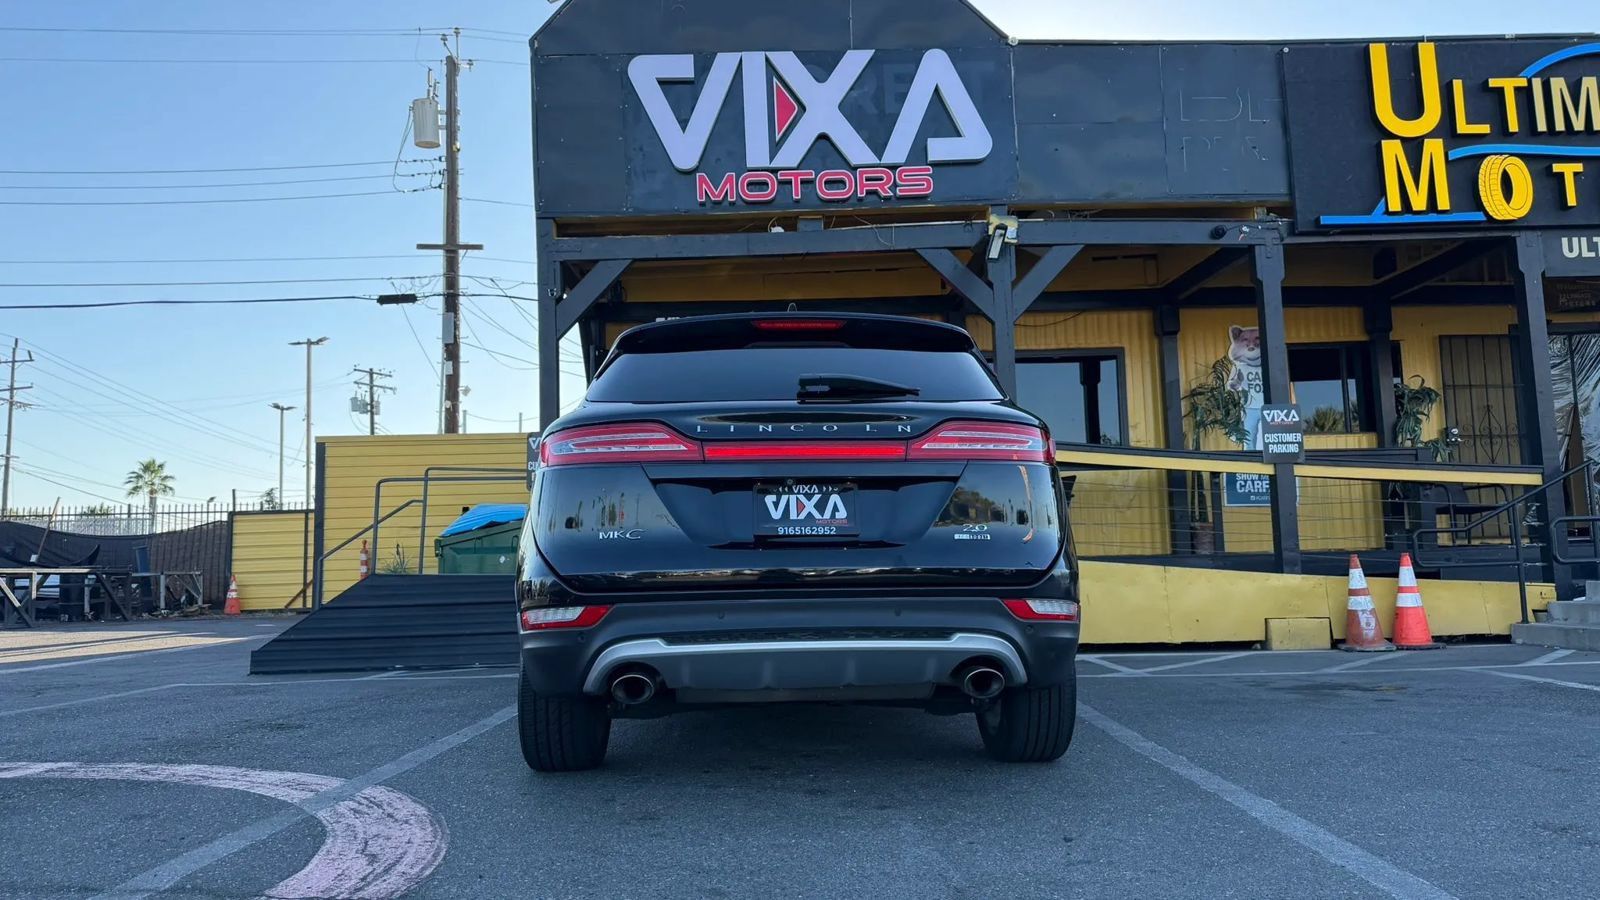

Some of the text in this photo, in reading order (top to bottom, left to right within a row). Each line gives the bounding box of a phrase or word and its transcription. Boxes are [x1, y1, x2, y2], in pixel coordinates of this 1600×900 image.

[628, 48, 993, 171] VIXA
[696, 165, 934, 203] MOTORS
[1248, 383, 1264, 394] FO
[1262, 409, 1300, 422] VIXA
[697, 424, 912, 432] LINCOLN
[1264, 432, 1302, 443] CUSTOMER
[1269, 443, 1299, 454] PARKING
[792, 484, 819, 494] VIXA
[1236, 480, 1270, 493] CARF
[764, 493, 848, 520] VIXA
[599, 528, 644, 540] MKC
[777, 526, 837, 535] 9165162952
